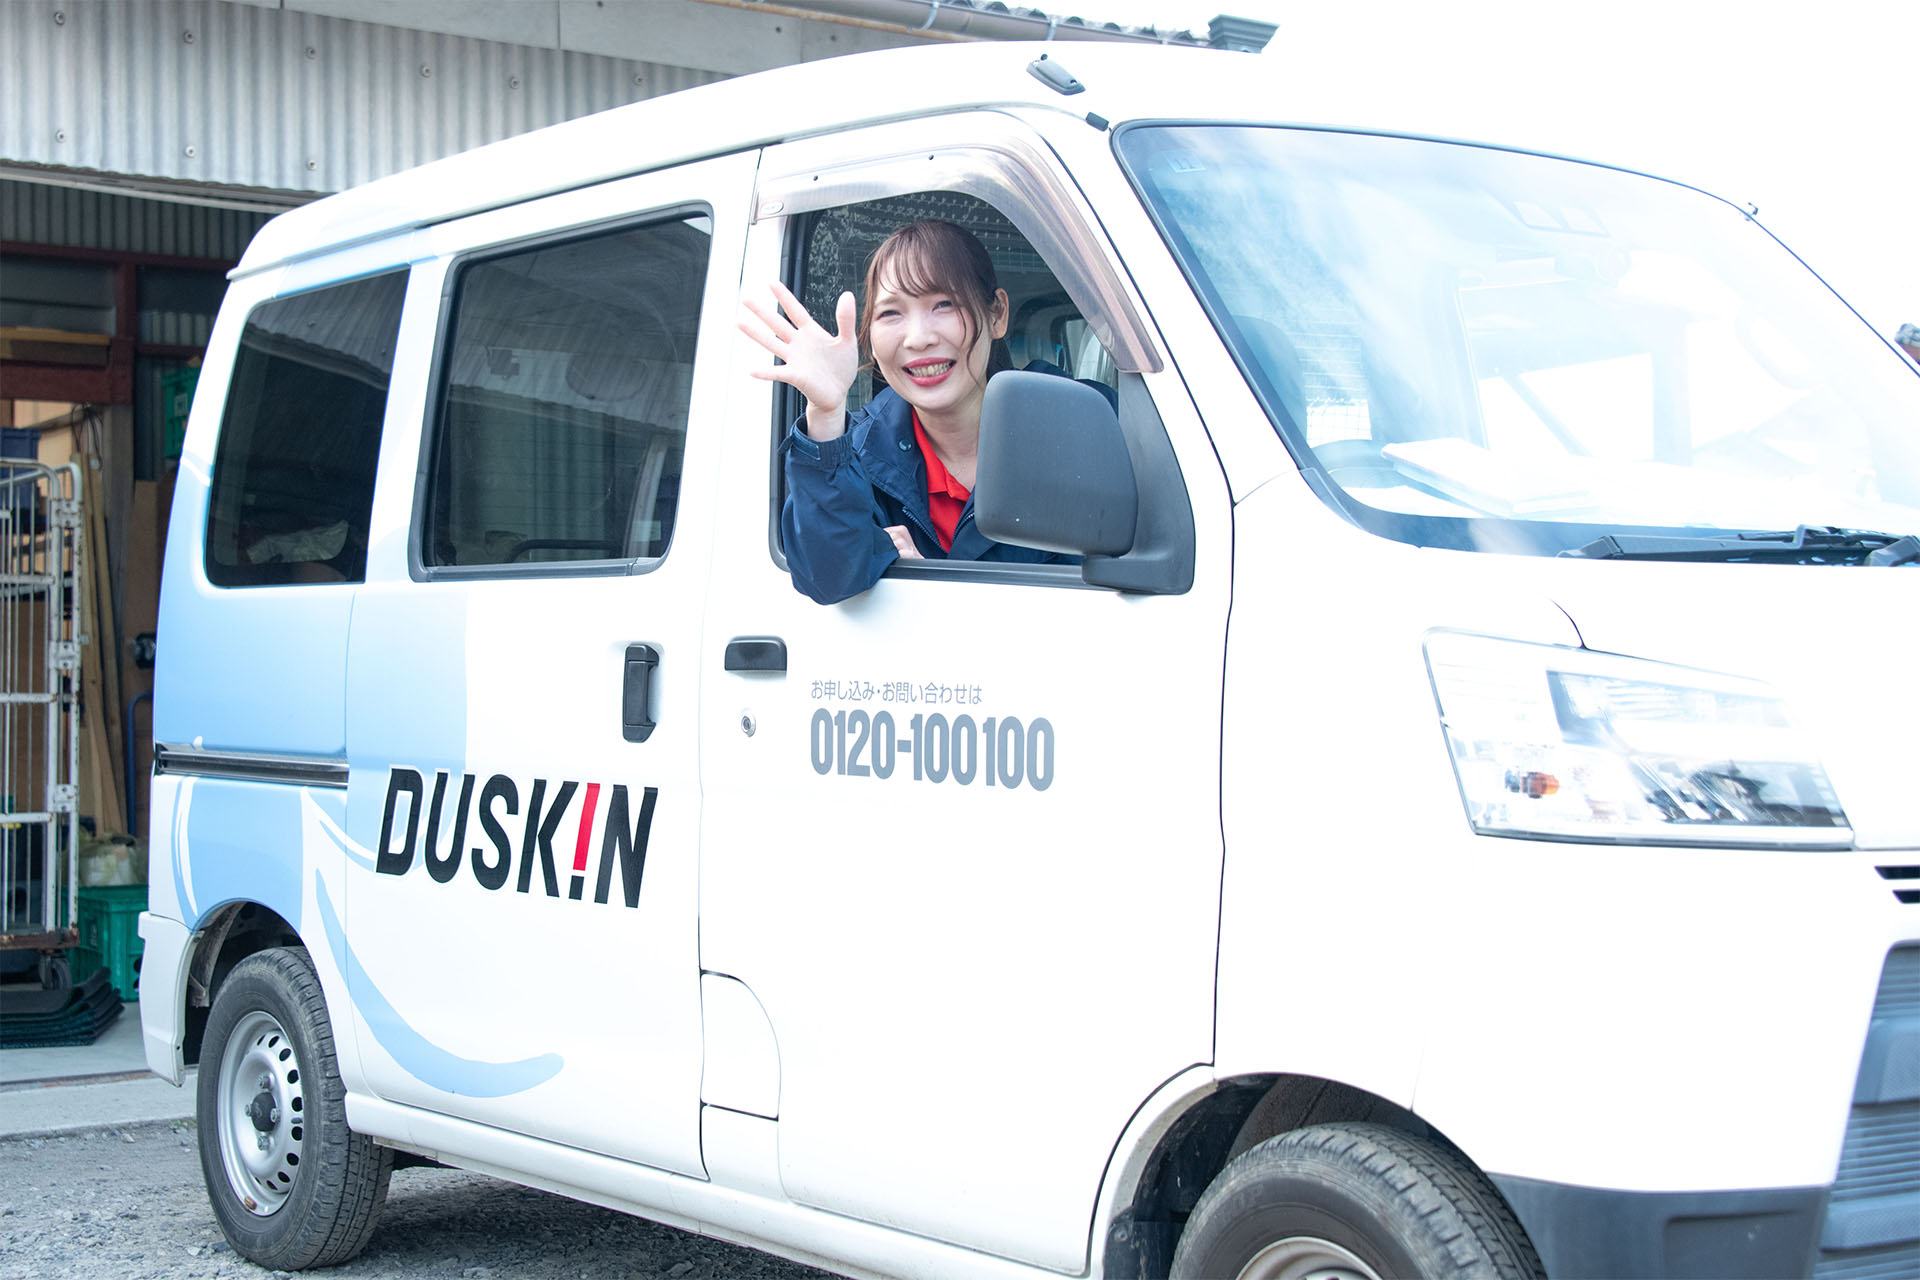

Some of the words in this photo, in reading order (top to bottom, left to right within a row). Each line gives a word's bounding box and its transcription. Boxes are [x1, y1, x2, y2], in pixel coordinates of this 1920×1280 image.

[811, 680, 982, 705] お申し込み・お問い合わせは
